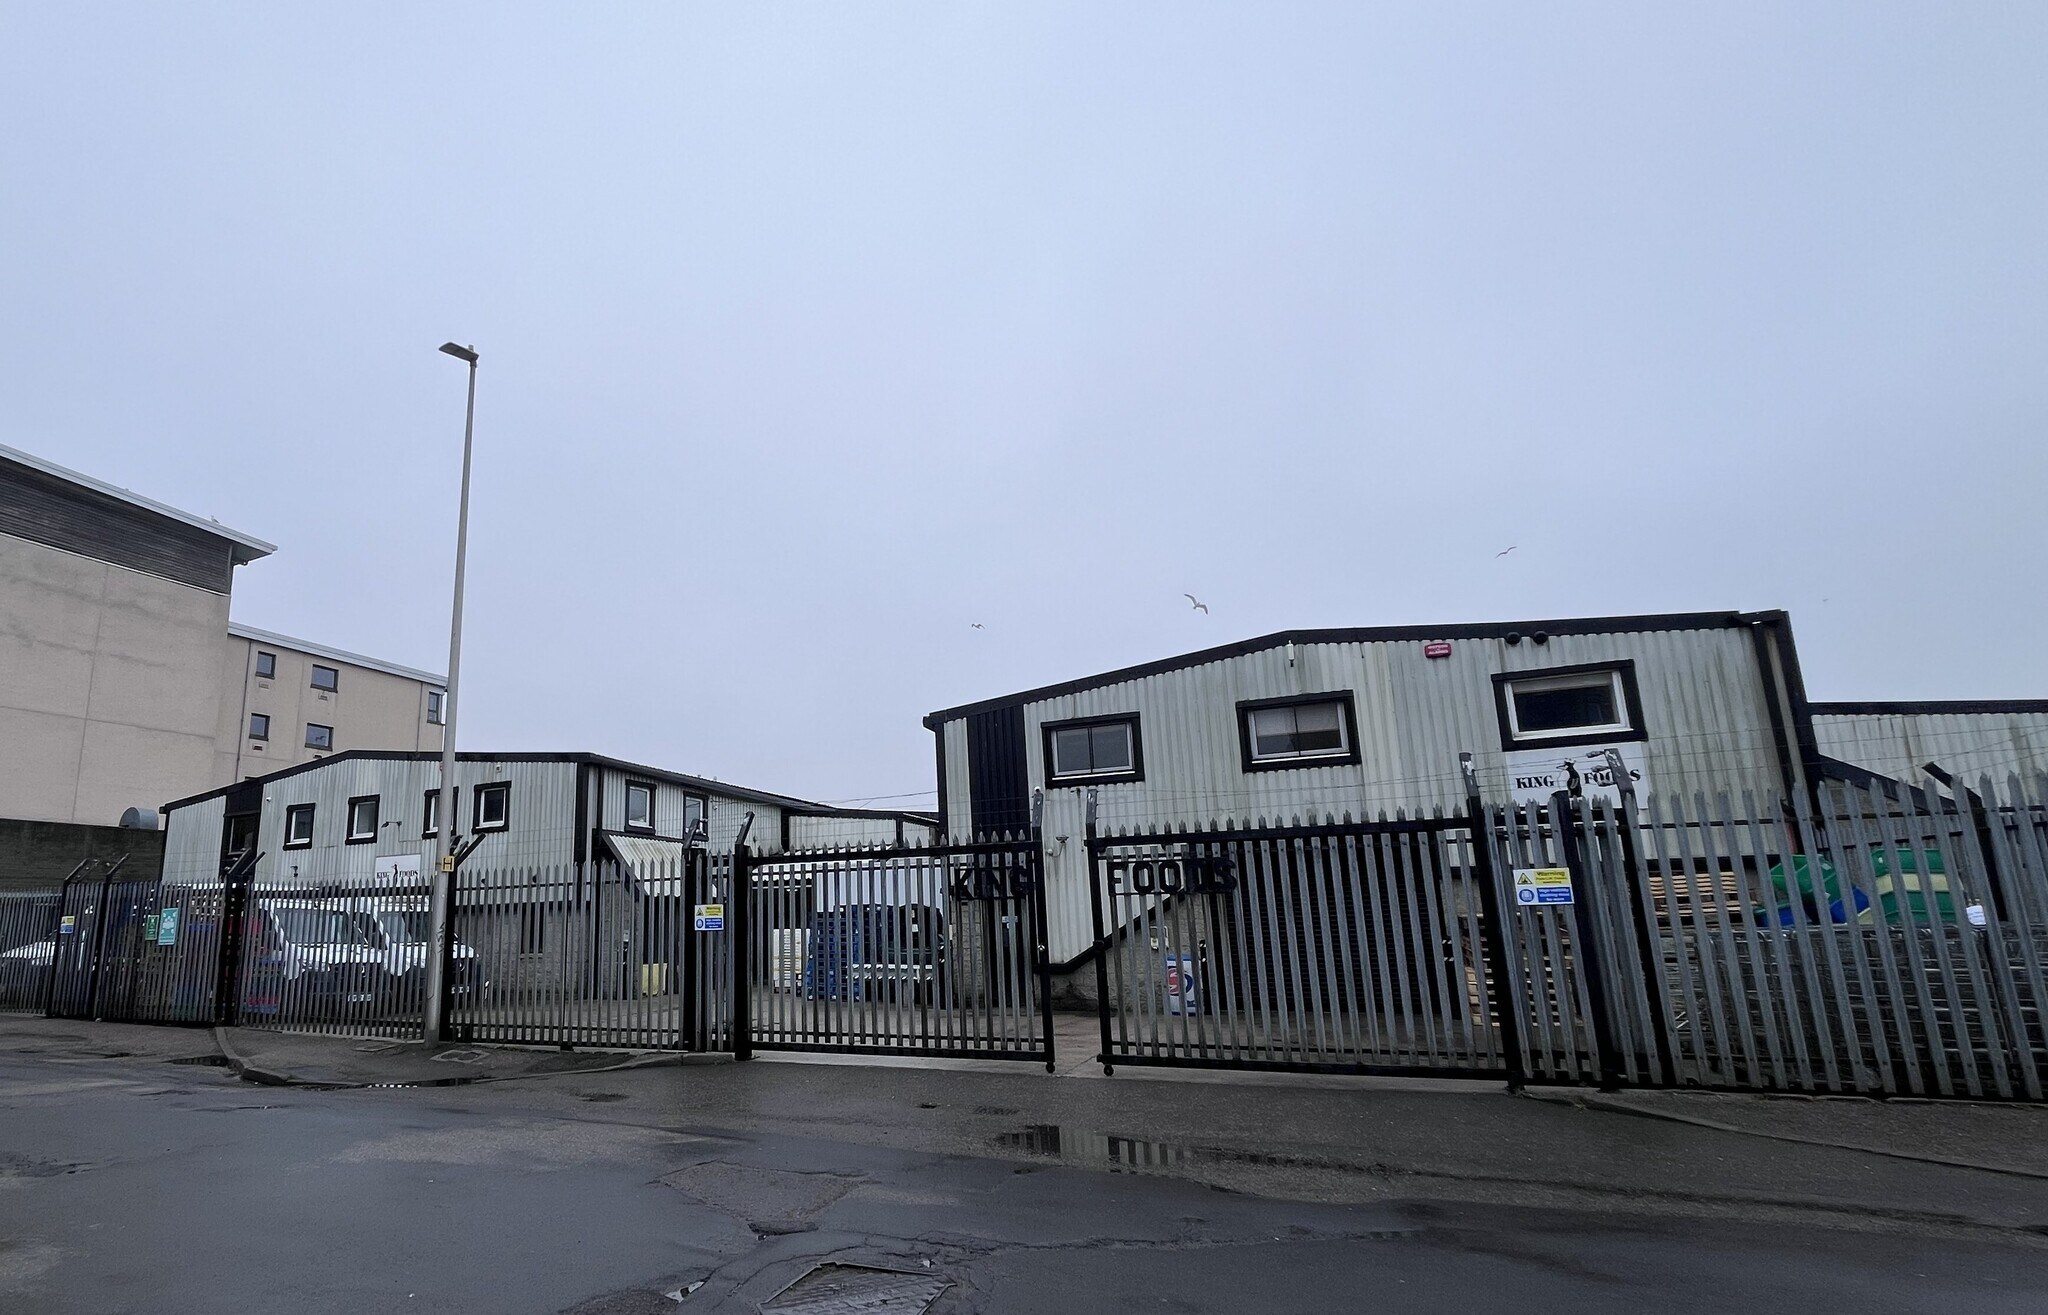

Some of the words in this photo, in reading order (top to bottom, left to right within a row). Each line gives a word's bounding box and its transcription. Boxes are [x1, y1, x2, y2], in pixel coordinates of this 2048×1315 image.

[1516, 776, 1555, 789] KING
[1584, 769, 1641, 784] FOOS
[443, 857, 453, 870] H
